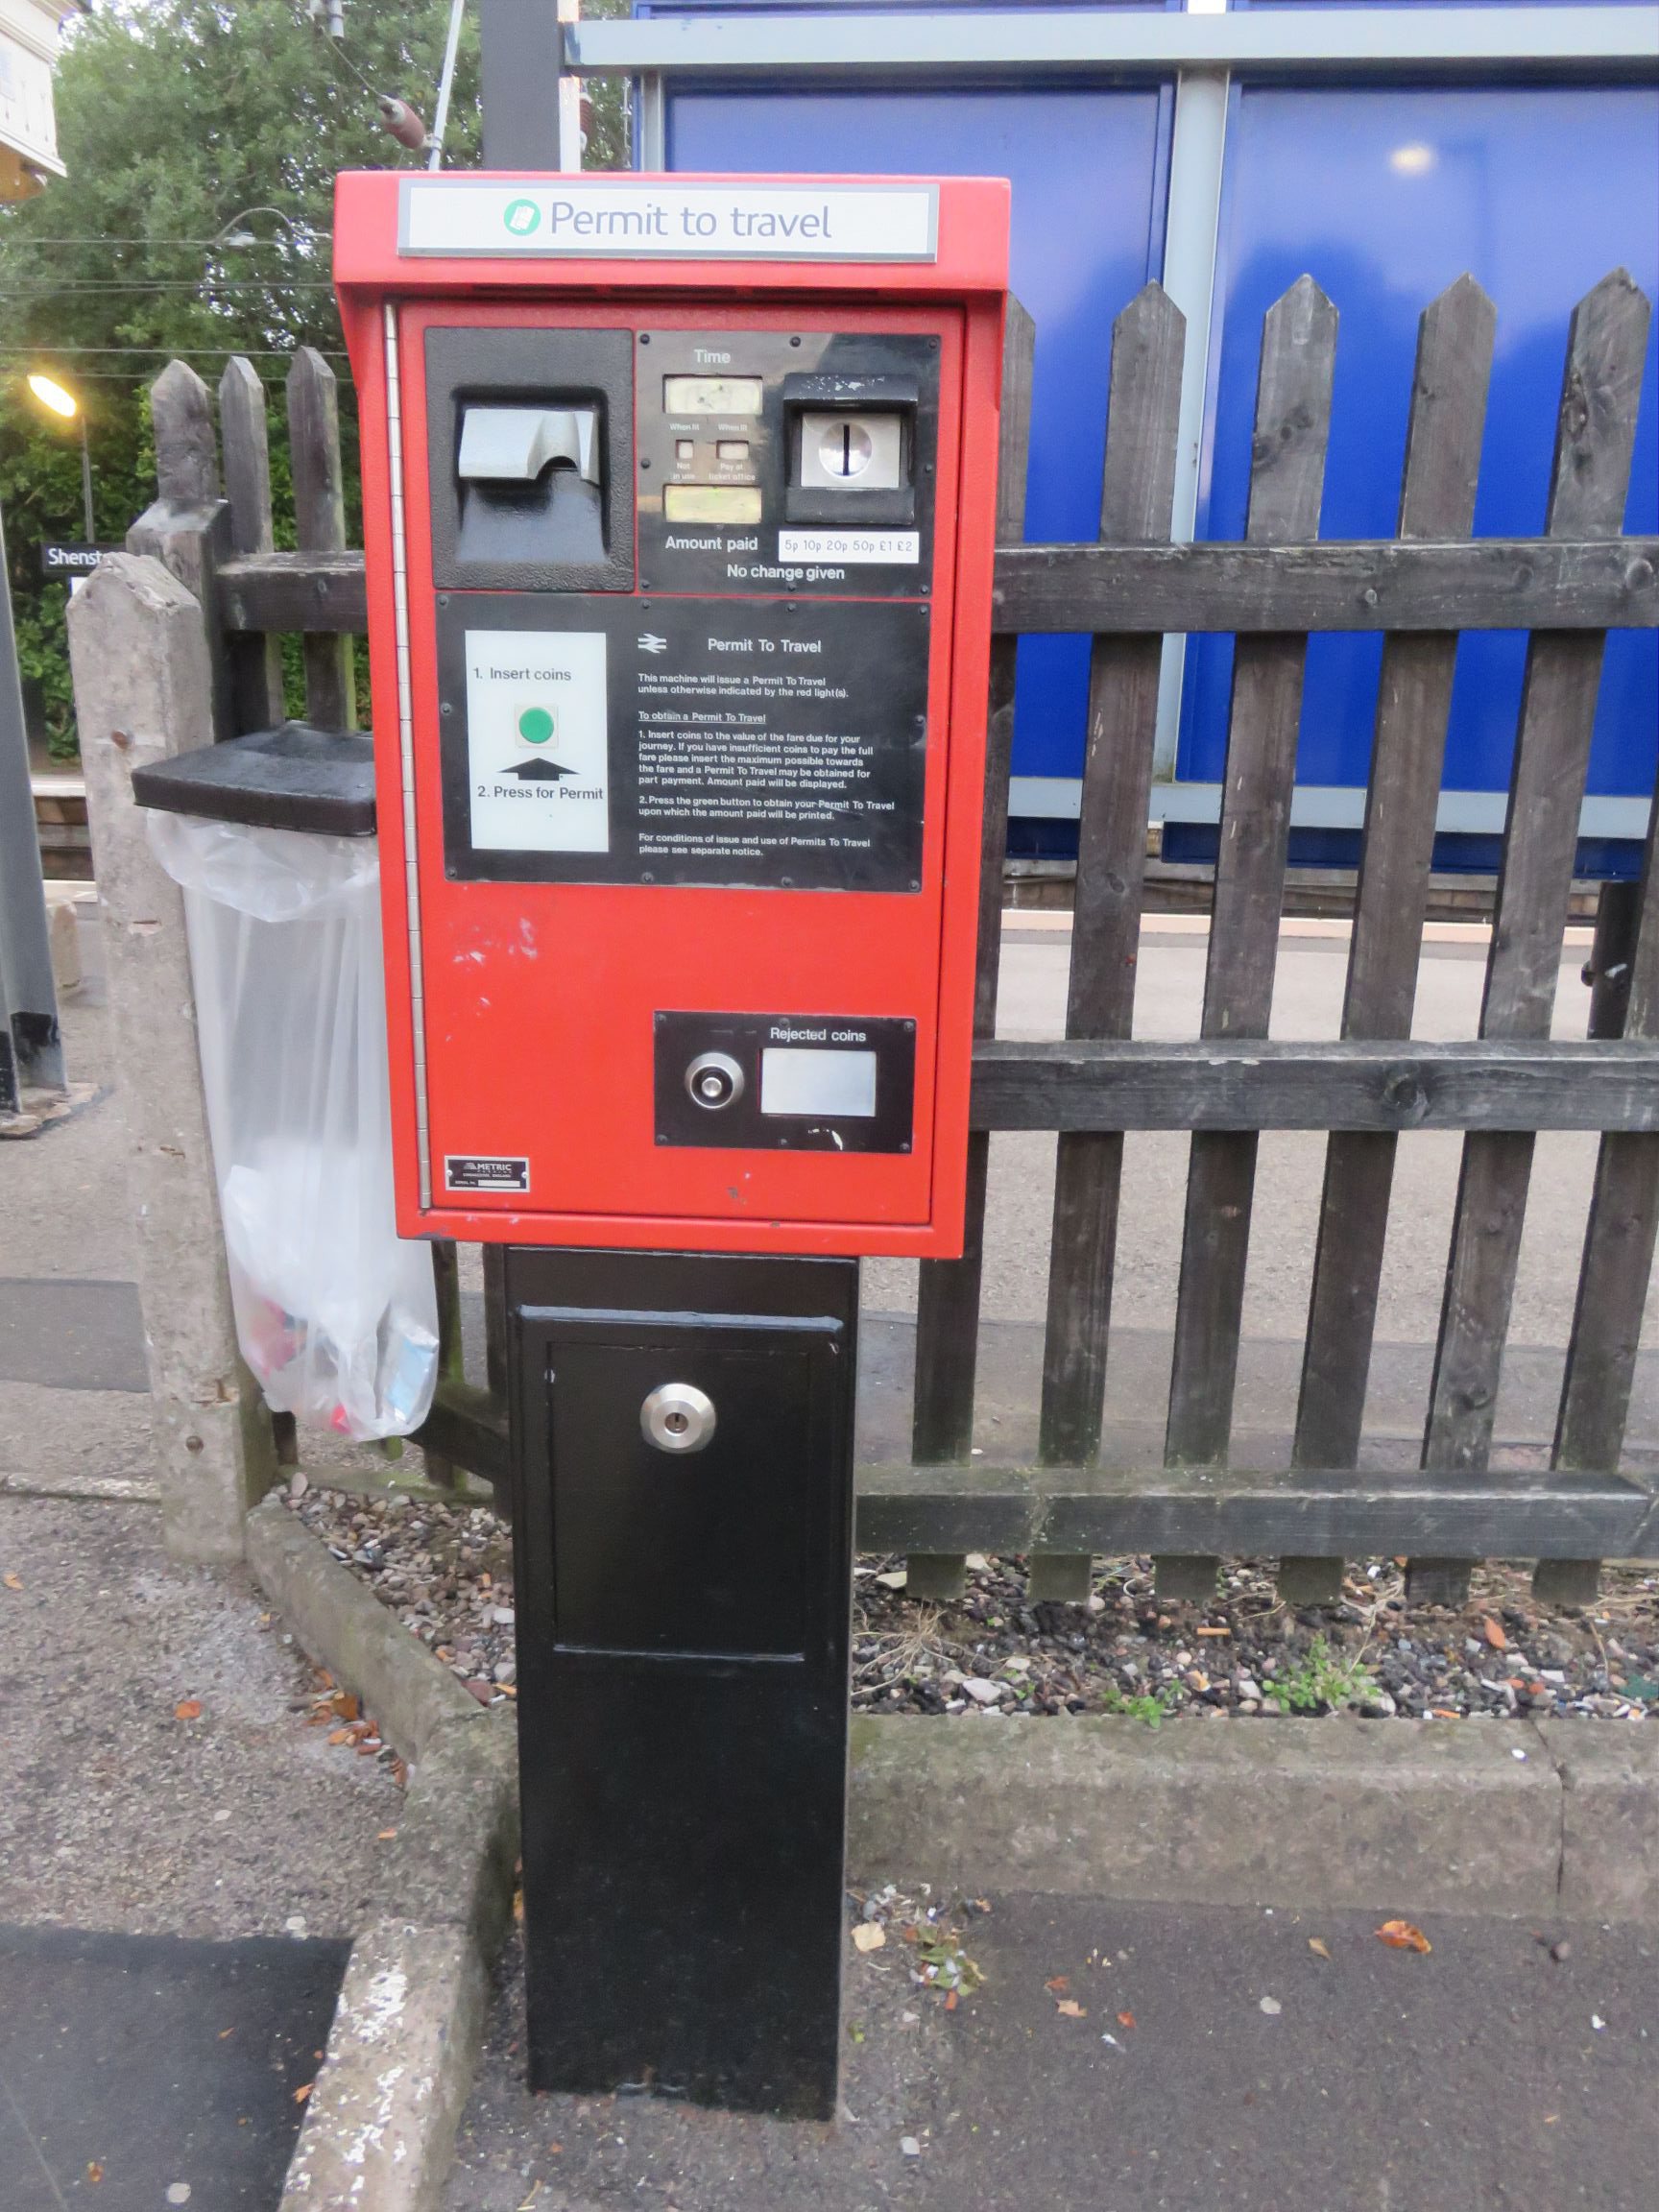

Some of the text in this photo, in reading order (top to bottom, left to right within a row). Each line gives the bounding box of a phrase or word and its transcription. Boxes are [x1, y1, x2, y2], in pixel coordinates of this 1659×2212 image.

[551, 202, 831, 238] Permit to travel
[694, 349, 731, 363] Time
[665, 536, 758, 552] Amount paid
[784, 540, 912, 553] 5p 10p 20p 50p £1 £2
[728, 565, 844, 582] No change given
[708, 638, 821, 652] Permit To Travel
[473, 667, 571, 681] 1. Insert coins
[638, 673, 658, 682] This
[660, 674, 698, 683] machine
[753, 676, 783, 685] Permit
[799, 677, 826, 685] Travel
[719, 686, 761, 695] indicated
[765, 687, 775, 697] by
[815, 688, 849, 698] light(s).
[638, 711, 649, 720] To
[652, 711, 681, 720] obtain
[692, 712, 722, 721] Permit
[738, 713, 765, 722] Travel
[638, 741, 676, 752] journey.
[730, 744, 781, 753] insufficient
[638, 753, 656, 761] fare
[659, 754, 688, 762] please
[737, 756, 781, 764] maximum
[785, 757, 824, 765] possible
[827, 757, 863, 766] towards
[677, 765, 694, 774] and
[800, 768, 811, 777] be
[814, 769, 854, 778] obtained
[638, 777, 658, 785] part
[708, 777, 743, 785] Amount
[746, 779, 765, 787] paid
[800, 780, 847, 789] displayed.
[478, 785, 603, 799] 2. Press for Permit
[763, 799, 792, 807] obtain
[819, 800, 849, 808] Permit
[853, 801, 863, 809] To
[867, 801, 894, 810] Travel
[663, 807, 689, 816] which
[746, 810, 766, 819] paid
[799, 811, 834, 821] printed.
[656, 834, 703, 843] conditions
[842, 838, 870, 847] Travel
[639, 845, 668, 854] please
[691, 847, 730, 855] separate
[770, 1027, 866, 1042] Rejected coins
